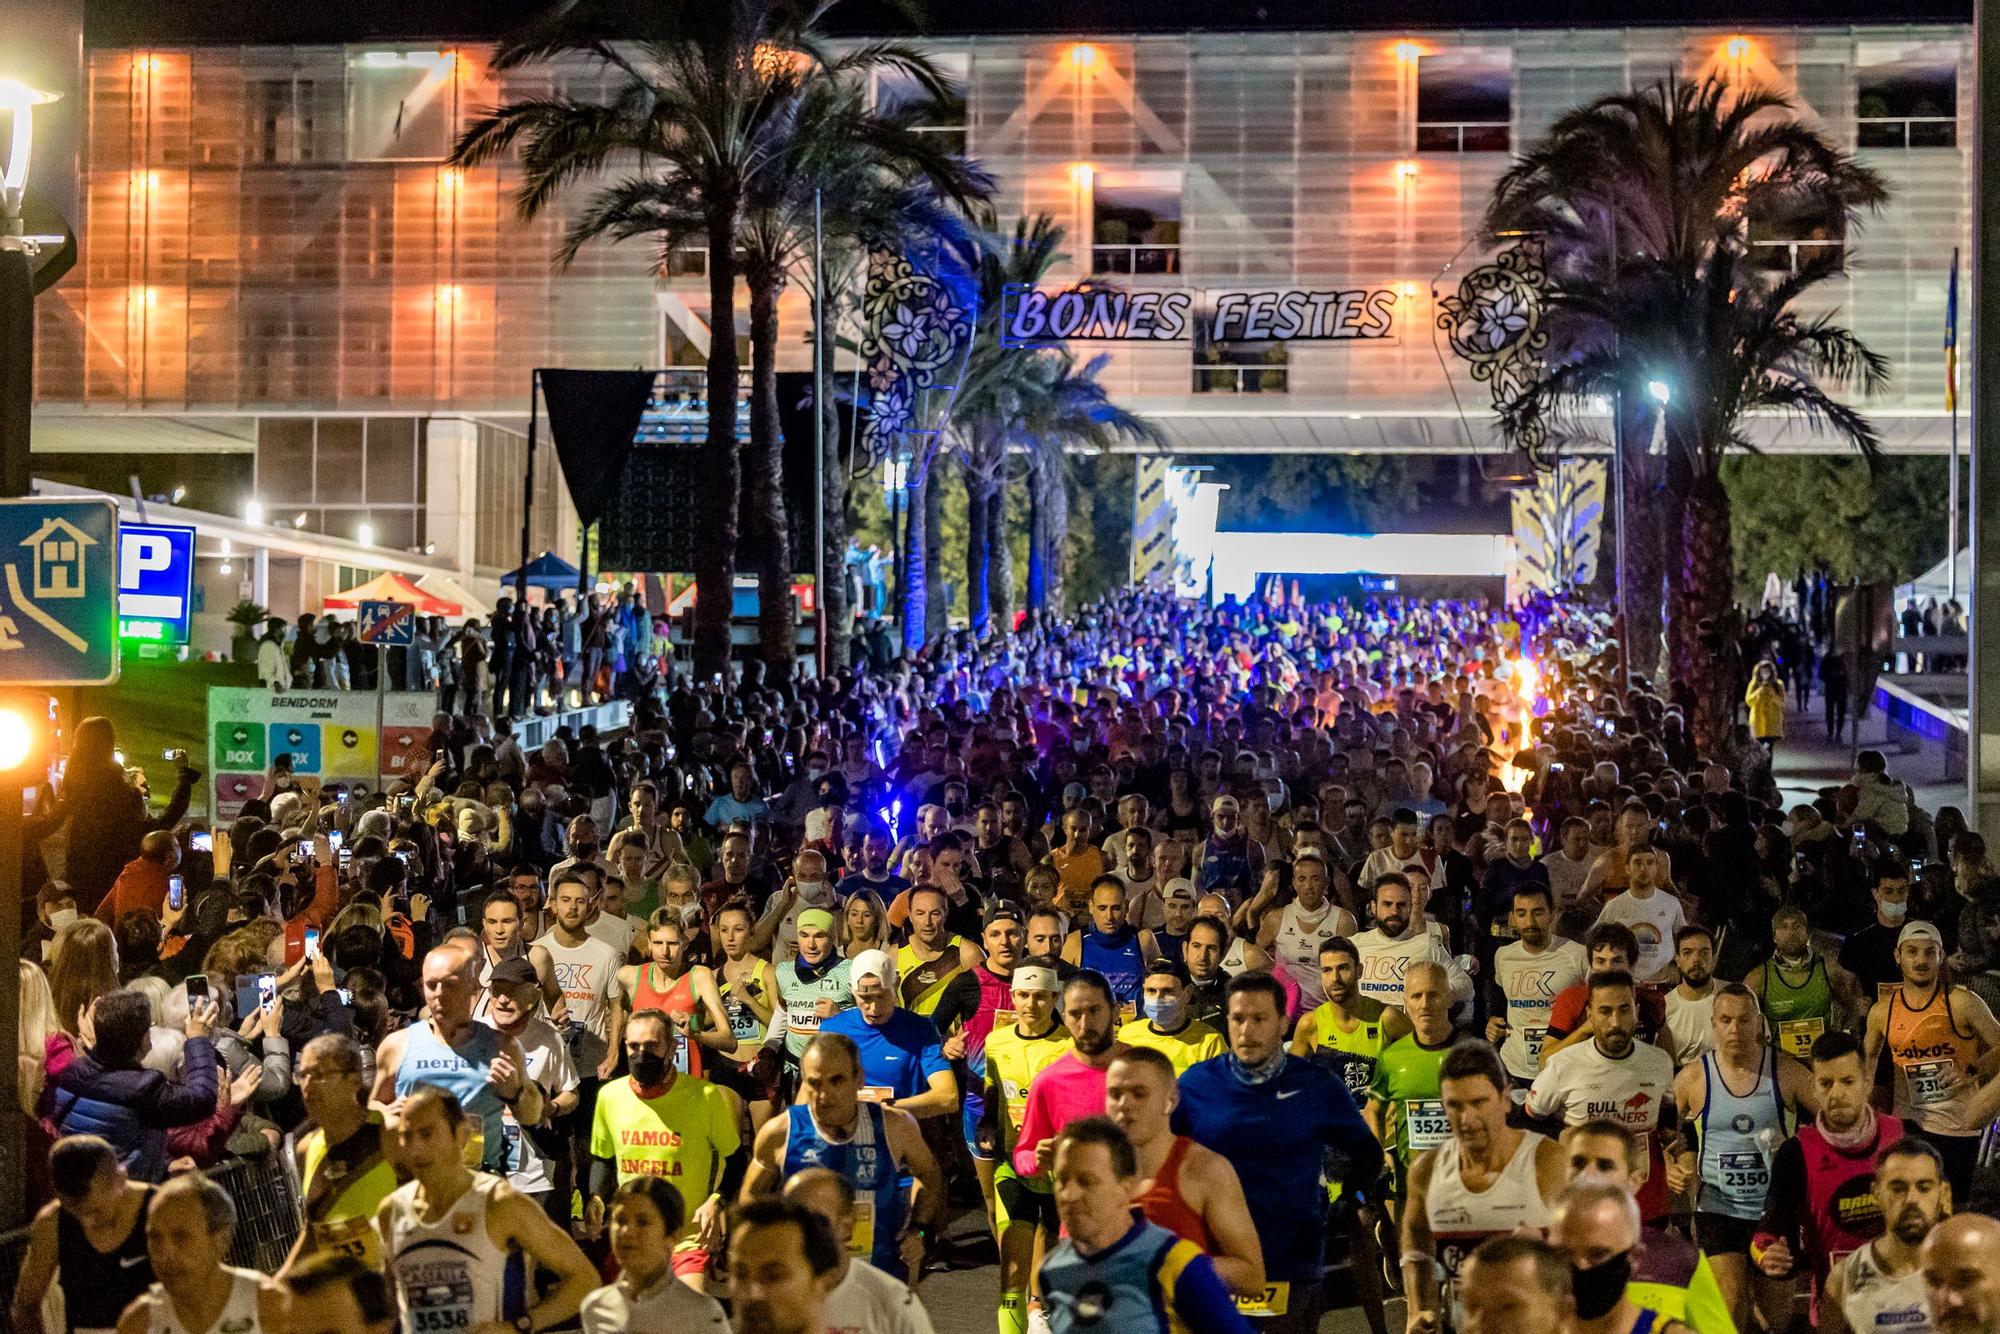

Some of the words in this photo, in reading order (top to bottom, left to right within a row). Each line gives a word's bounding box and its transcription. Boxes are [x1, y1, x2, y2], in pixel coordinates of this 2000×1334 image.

[1010, 290, 1191, 339] BONES
[1213, 290, 1398, 342] FESTES
[121, 534, 172, 590] P
[271, 697, 338, 709] BENIDORM
[225, 751, 254, 764] BOX
[1361, 983, 1404, 992] BENIDOR
[1795, 1034, 1811, 1046] 33
[1587, 1101, 1618, 1113] BULL
[1414, 1119, 1453, 1134] 3523
[621, 1130, 682, 1147] VAMOS
[1725, 1172, 1769, 1187] 2350
